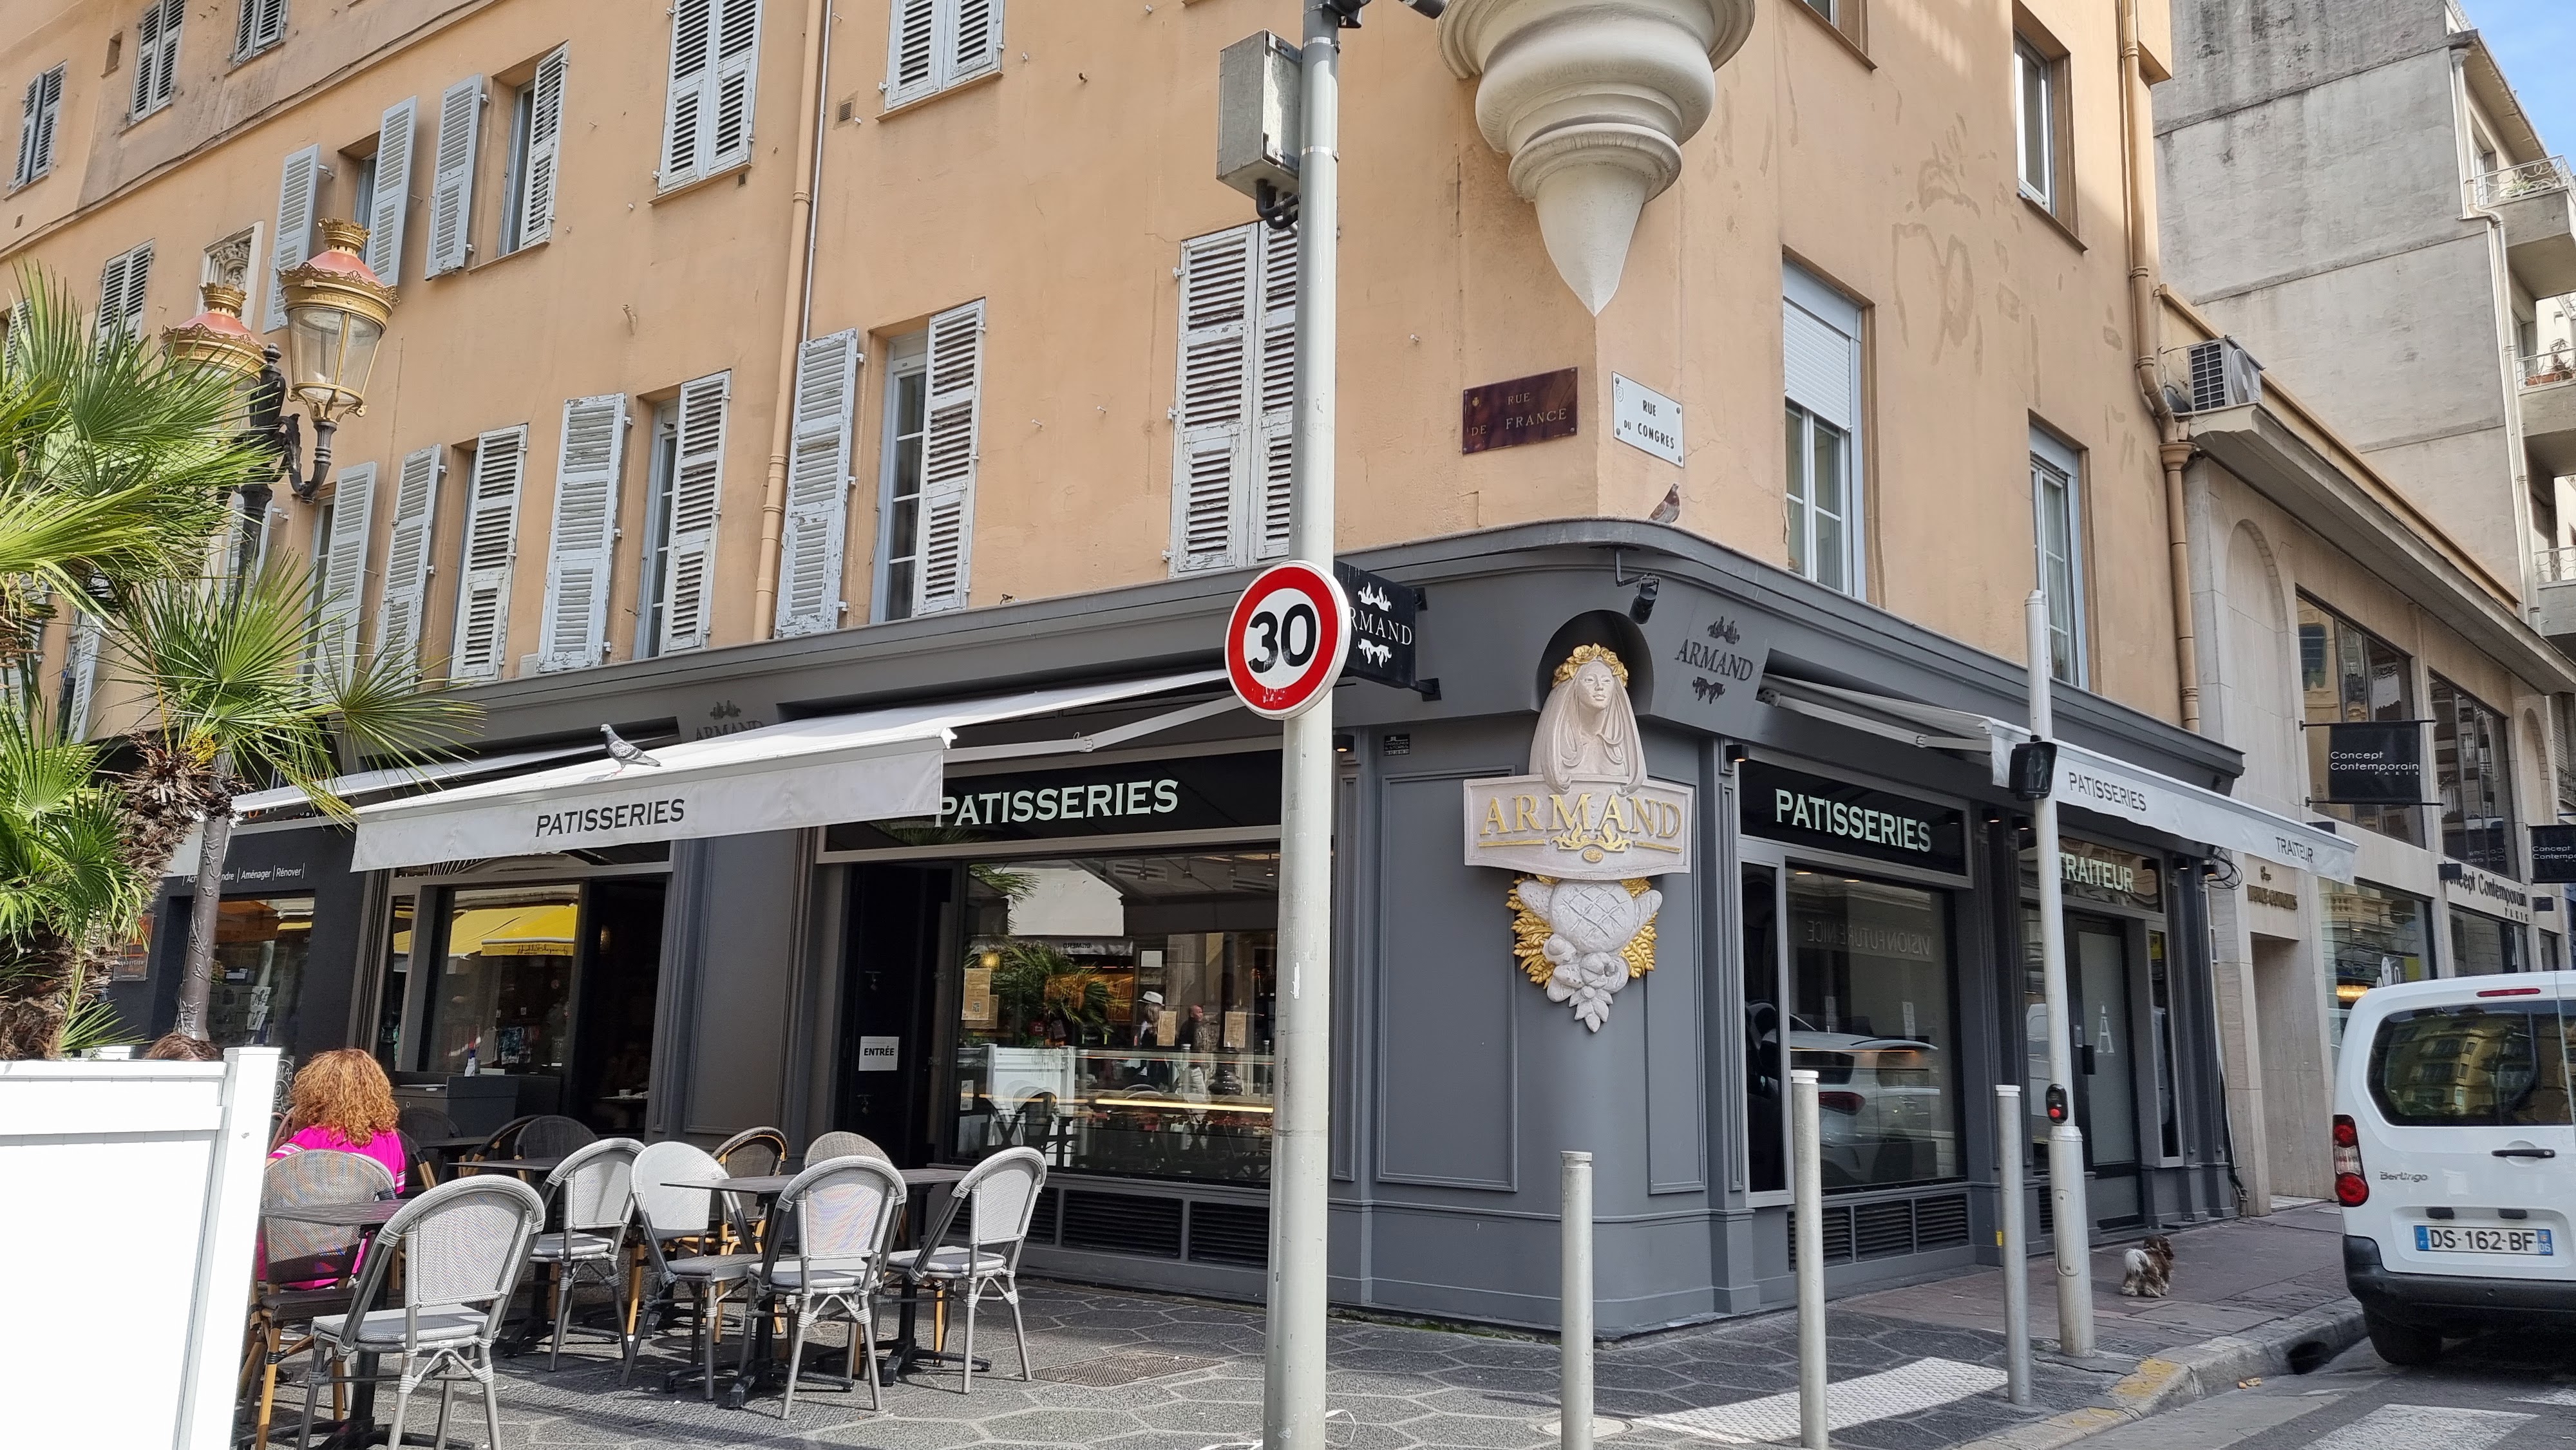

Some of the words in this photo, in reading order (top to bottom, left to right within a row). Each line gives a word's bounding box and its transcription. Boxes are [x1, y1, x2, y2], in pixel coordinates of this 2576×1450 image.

[1507, 392, 1530, 406] RUE
[1642, 399, 1657, 417] RUE
[1471, 424, 1486, 437] DE
[1506, 408, 1567, 430] FRANCE
[1624, 419, 1631, 431] DU
[1638, 422, 1675, 449] CONGRES
[1247, 603, 1316, 673] 30
[1350, 606, 1412, 646] RMAND
[1675, 639, 1754, 681] ARMAND
[2330, 751, 2383, 760] Concept
[2330, 762, 2420, 772] Contemporain
[934, 779, 1179, 827] PATISSERIES
[2069, 772, 2146, 813] PATISSERIES
[535, 798, 685, 838] PATISSERIES
[1480, 793, 1682, 839] ARMAND
[1775, 788, 1932, 852] PATISSERIES
[2275, 836, 2313, 864] TRAITEUR
[241, 869, 272, 882] Aménager
[276, 866, 302, 878] Rénover
[2059, 852, 2134, 894] TRAITEUR
[2478, 873, 2527, 907] Contemporain
[864, 1045, 895, 1056] ENTRÉE
[2380, 1171, 2428, 1182] Berlingo
[2429, 1229, 2535, 1251] DS-162-BF
[2539, 1243, 2551, 1253] 06
